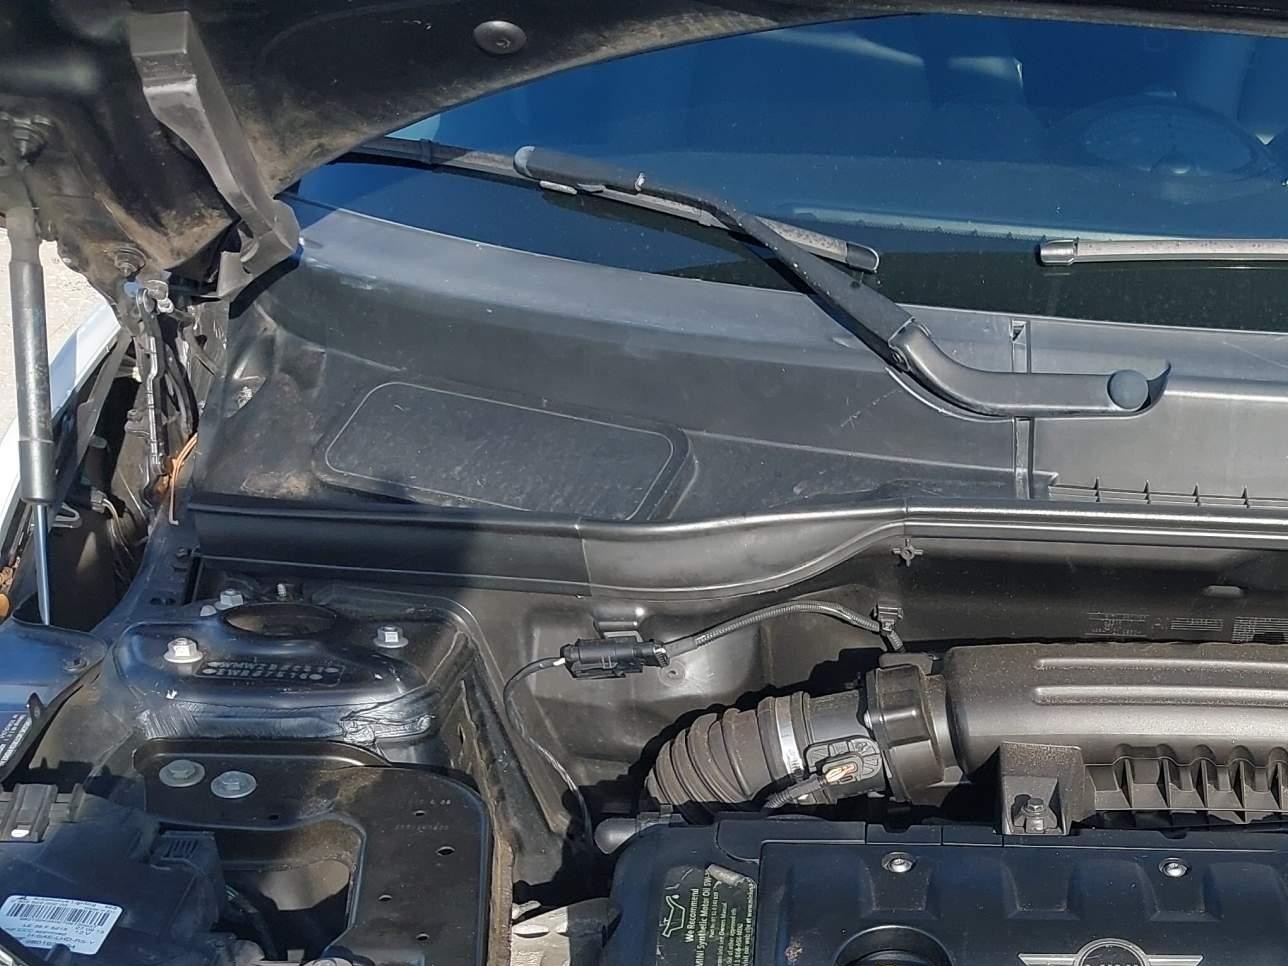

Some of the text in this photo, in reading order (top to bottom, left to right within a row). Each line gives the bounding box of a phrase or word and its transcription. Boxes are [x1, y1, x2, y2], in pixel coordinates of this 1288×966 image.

[685, 889, 699, 942] We Recommend
[701, 898, 710, 916] Motor
[697, 918, 707, 949] Synthetic
